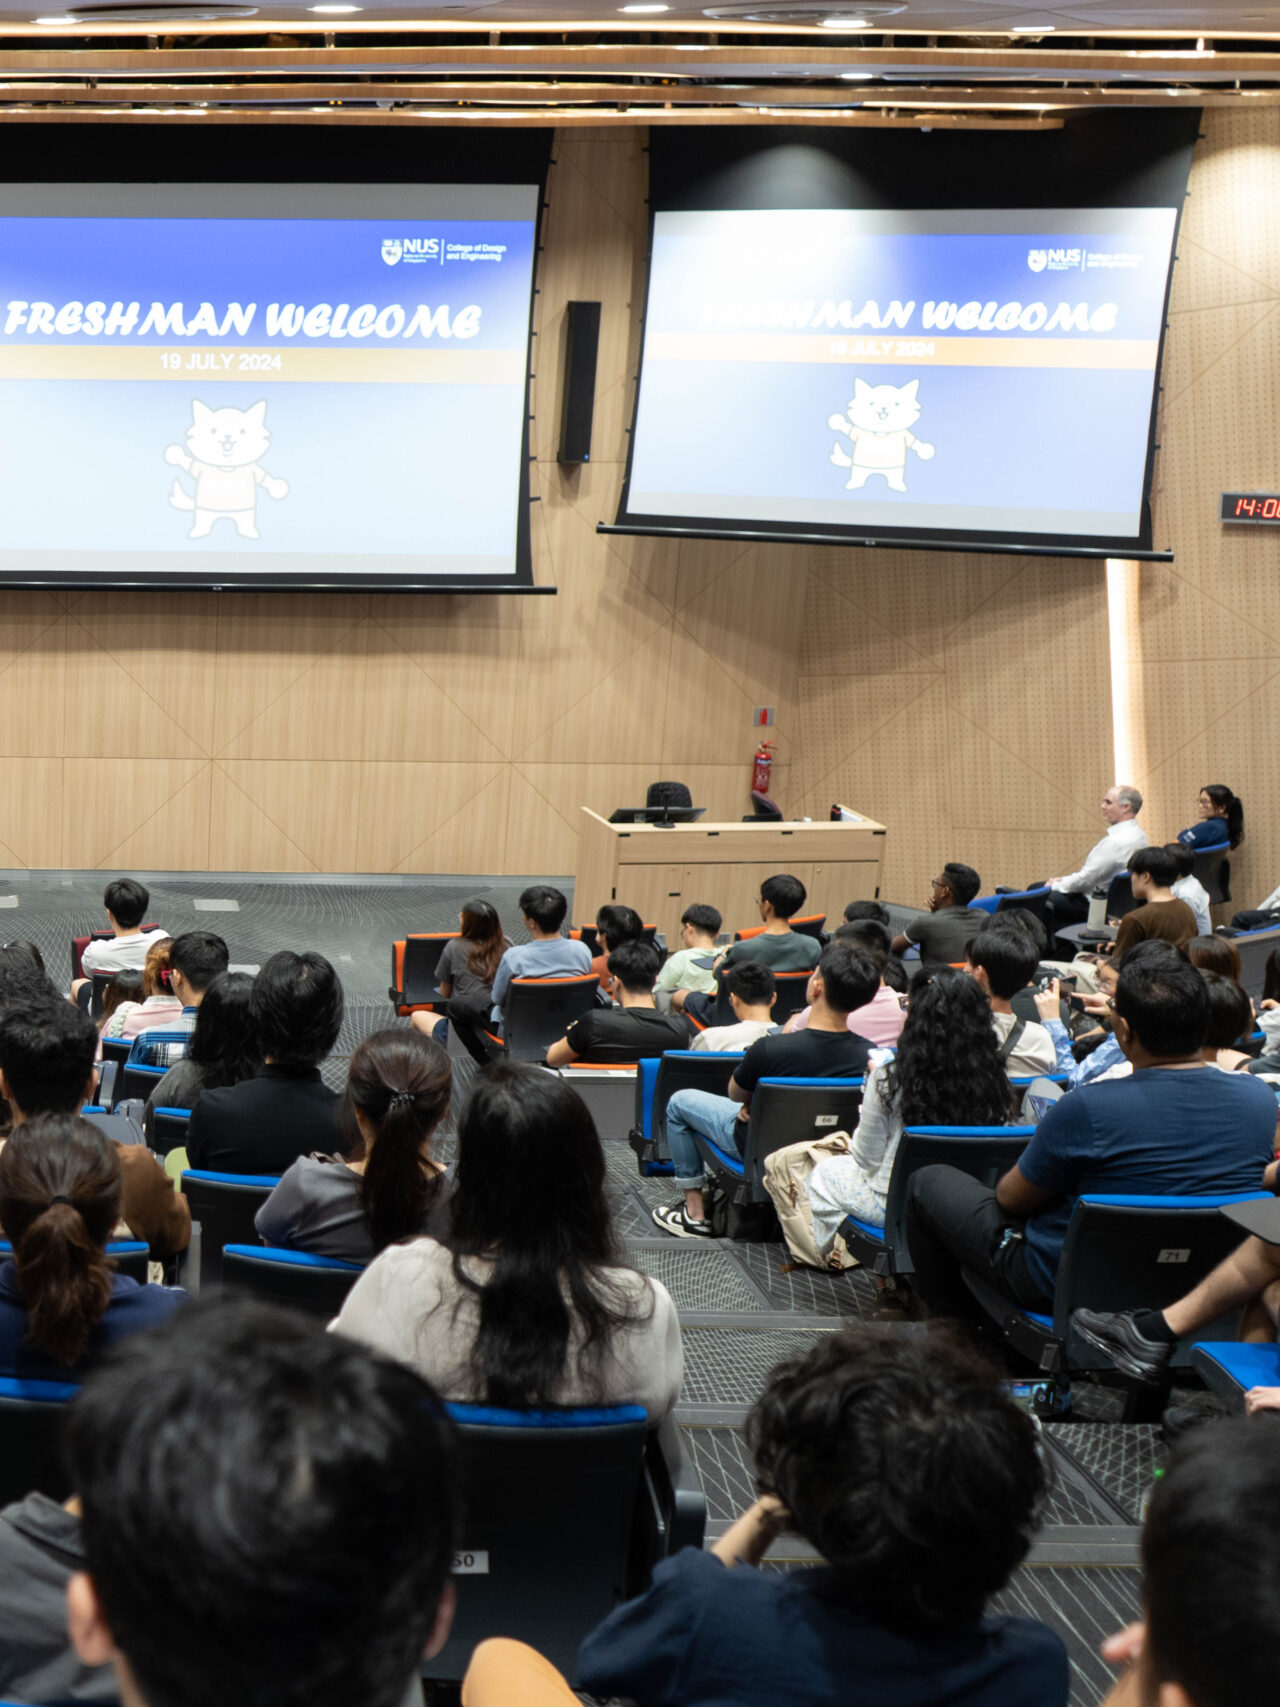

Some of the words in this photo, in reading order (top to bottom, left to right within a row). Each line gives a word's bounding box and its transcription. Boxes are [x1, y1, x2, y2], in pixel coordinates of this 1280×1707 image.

[403, 238, 439, 253] NUS
[1047, 248, 1081, 262] NUS
[3, 300, 257, 336] FRESHMAN
[265, 303, 483, 339] WELCOME
[922, 301, 1119, 333] WELCOME
[849, 341, 894, 356] JULY
[160, 353, 181, 370] 19
[185, 353, 234, 371] JULY
[237, 353, 282, 371] 2024
[1165, 1251, 1180, 1260] 71
